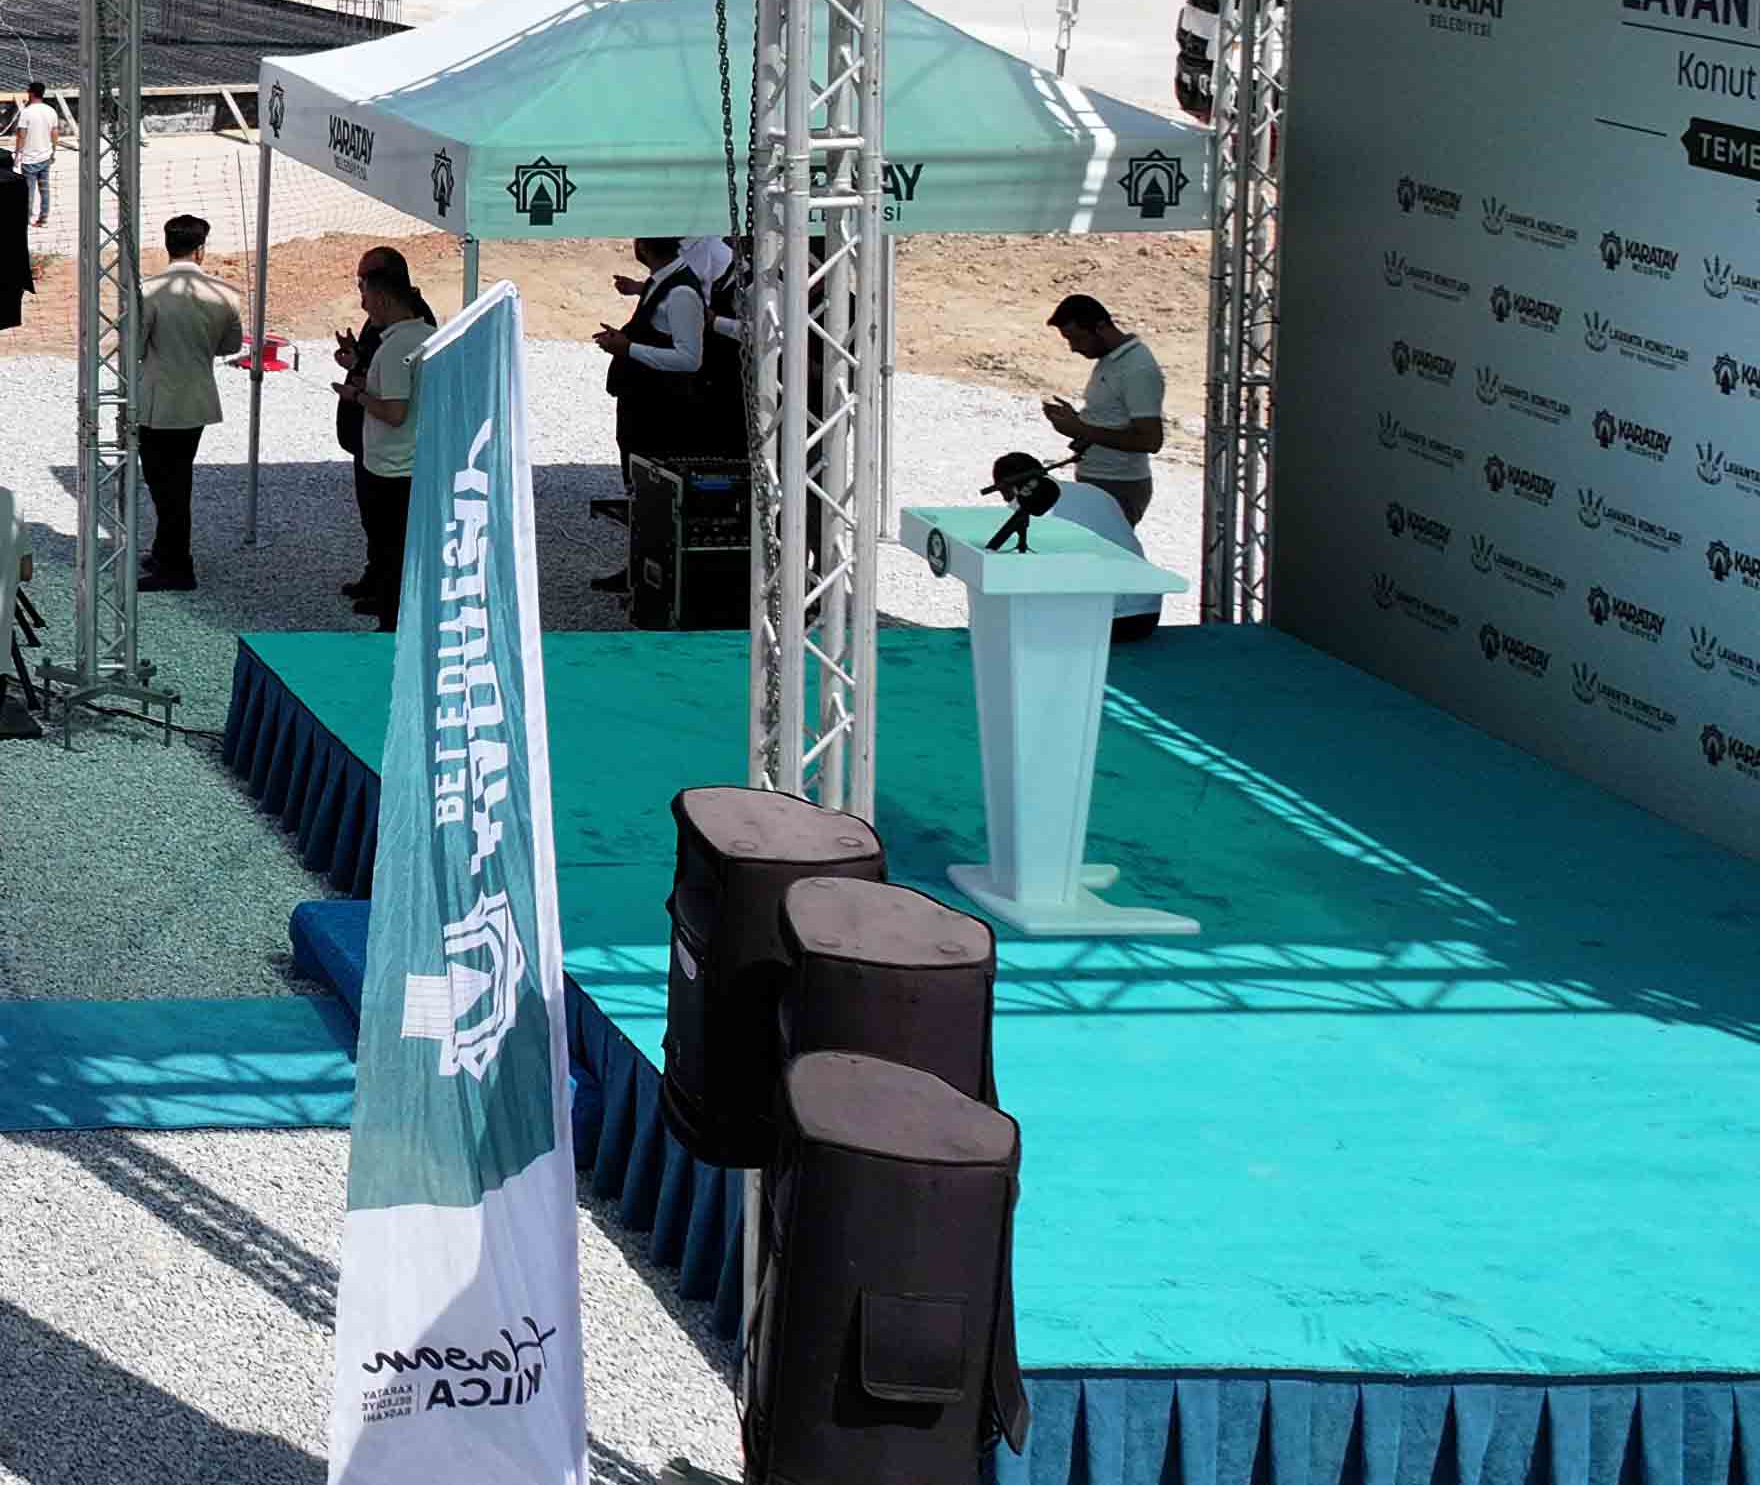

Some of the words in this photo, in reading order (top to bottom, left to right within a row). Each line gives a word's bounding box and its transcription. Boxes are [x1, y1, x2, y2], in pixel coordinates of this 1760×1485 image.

[1677, 50, 1757, 100] Konut
[328, 114, 375, 166] KARATAY
[1698, 132, 1760, 170] TEME
[1625, 237, 1680, 272] KARATAY
[1618, 419, 1672, 455] KARATAY
